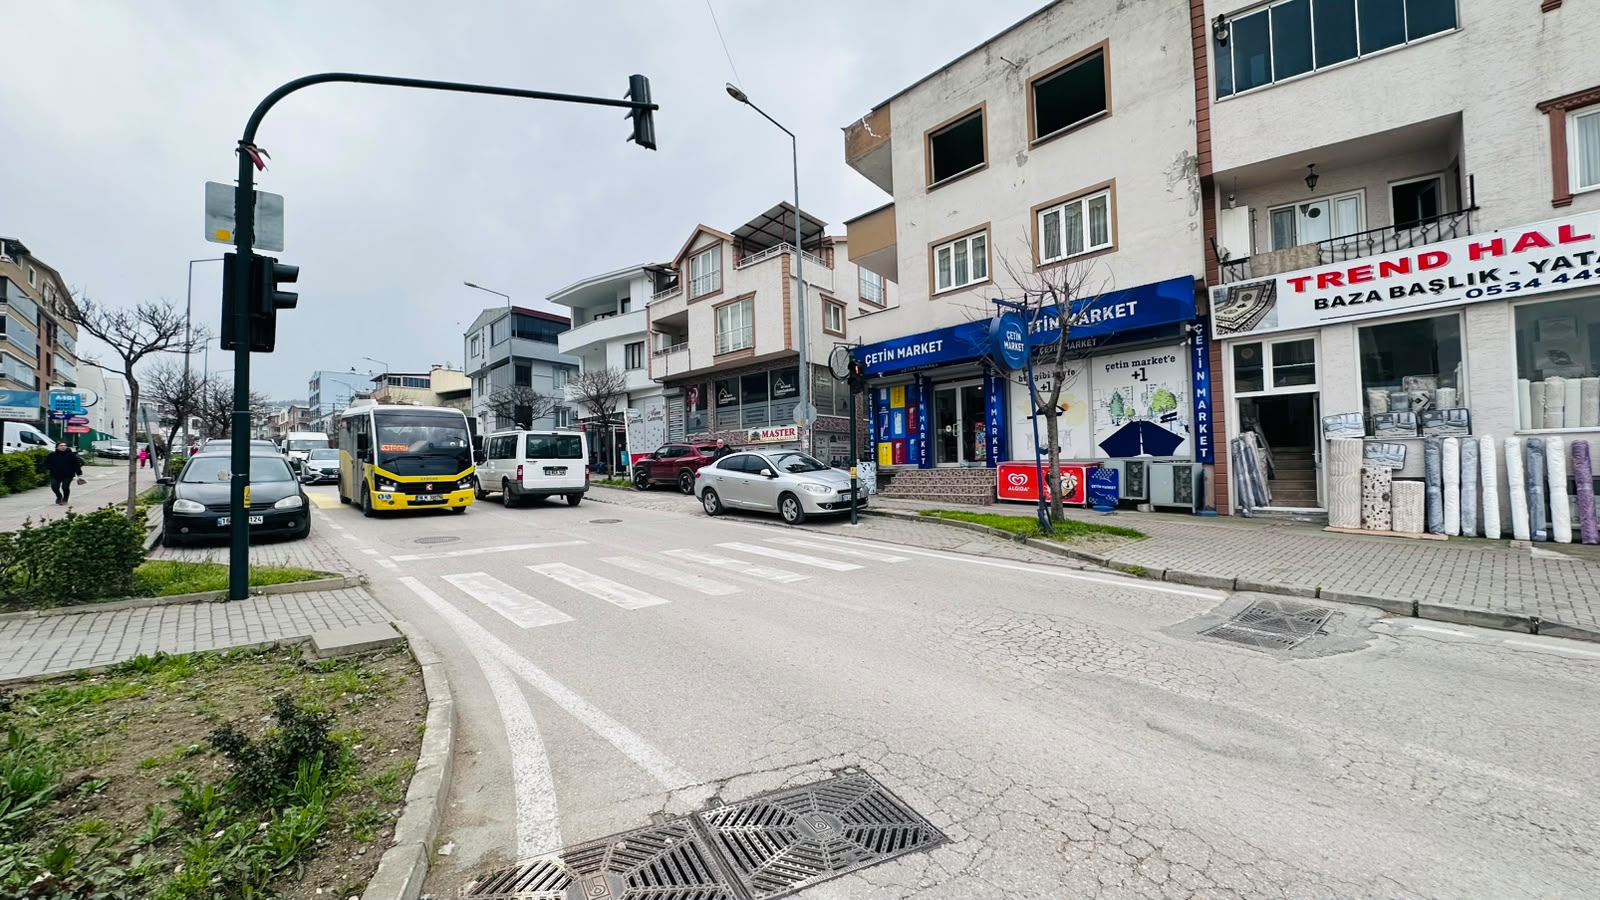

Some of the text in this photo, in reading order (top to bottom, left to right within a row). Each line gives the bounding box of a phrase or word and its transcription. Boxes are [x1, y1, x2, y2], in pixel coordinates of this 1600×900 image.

[1287, 224, 1593, 293] TREND HAL
[1314, 289, 1382, 310] BAZA
[1389, 267, 1499, 295] BAŞLIK
[1529, 251, 1600, 273] YAT
[1466, 279, 1542, 299] 0534
[1006, 330, 1022, 342] ÇETİN
[865, 340, 943, 367] ÇETİN MARKET
[1003, 341, 1025, 352] MARKET
[1105, 354, 1176, 373] çetin market'e
[1034, 370, 1050, 382] gibi
[1131, 367, 1148, 381] +1
[1041, 381, 1051, 391] +1
[1195, 323, 1208, 458] ÇETİN MARKET
[761, 428, 796, 438] MASTER
[991, 409, 999, 463] MARKET
